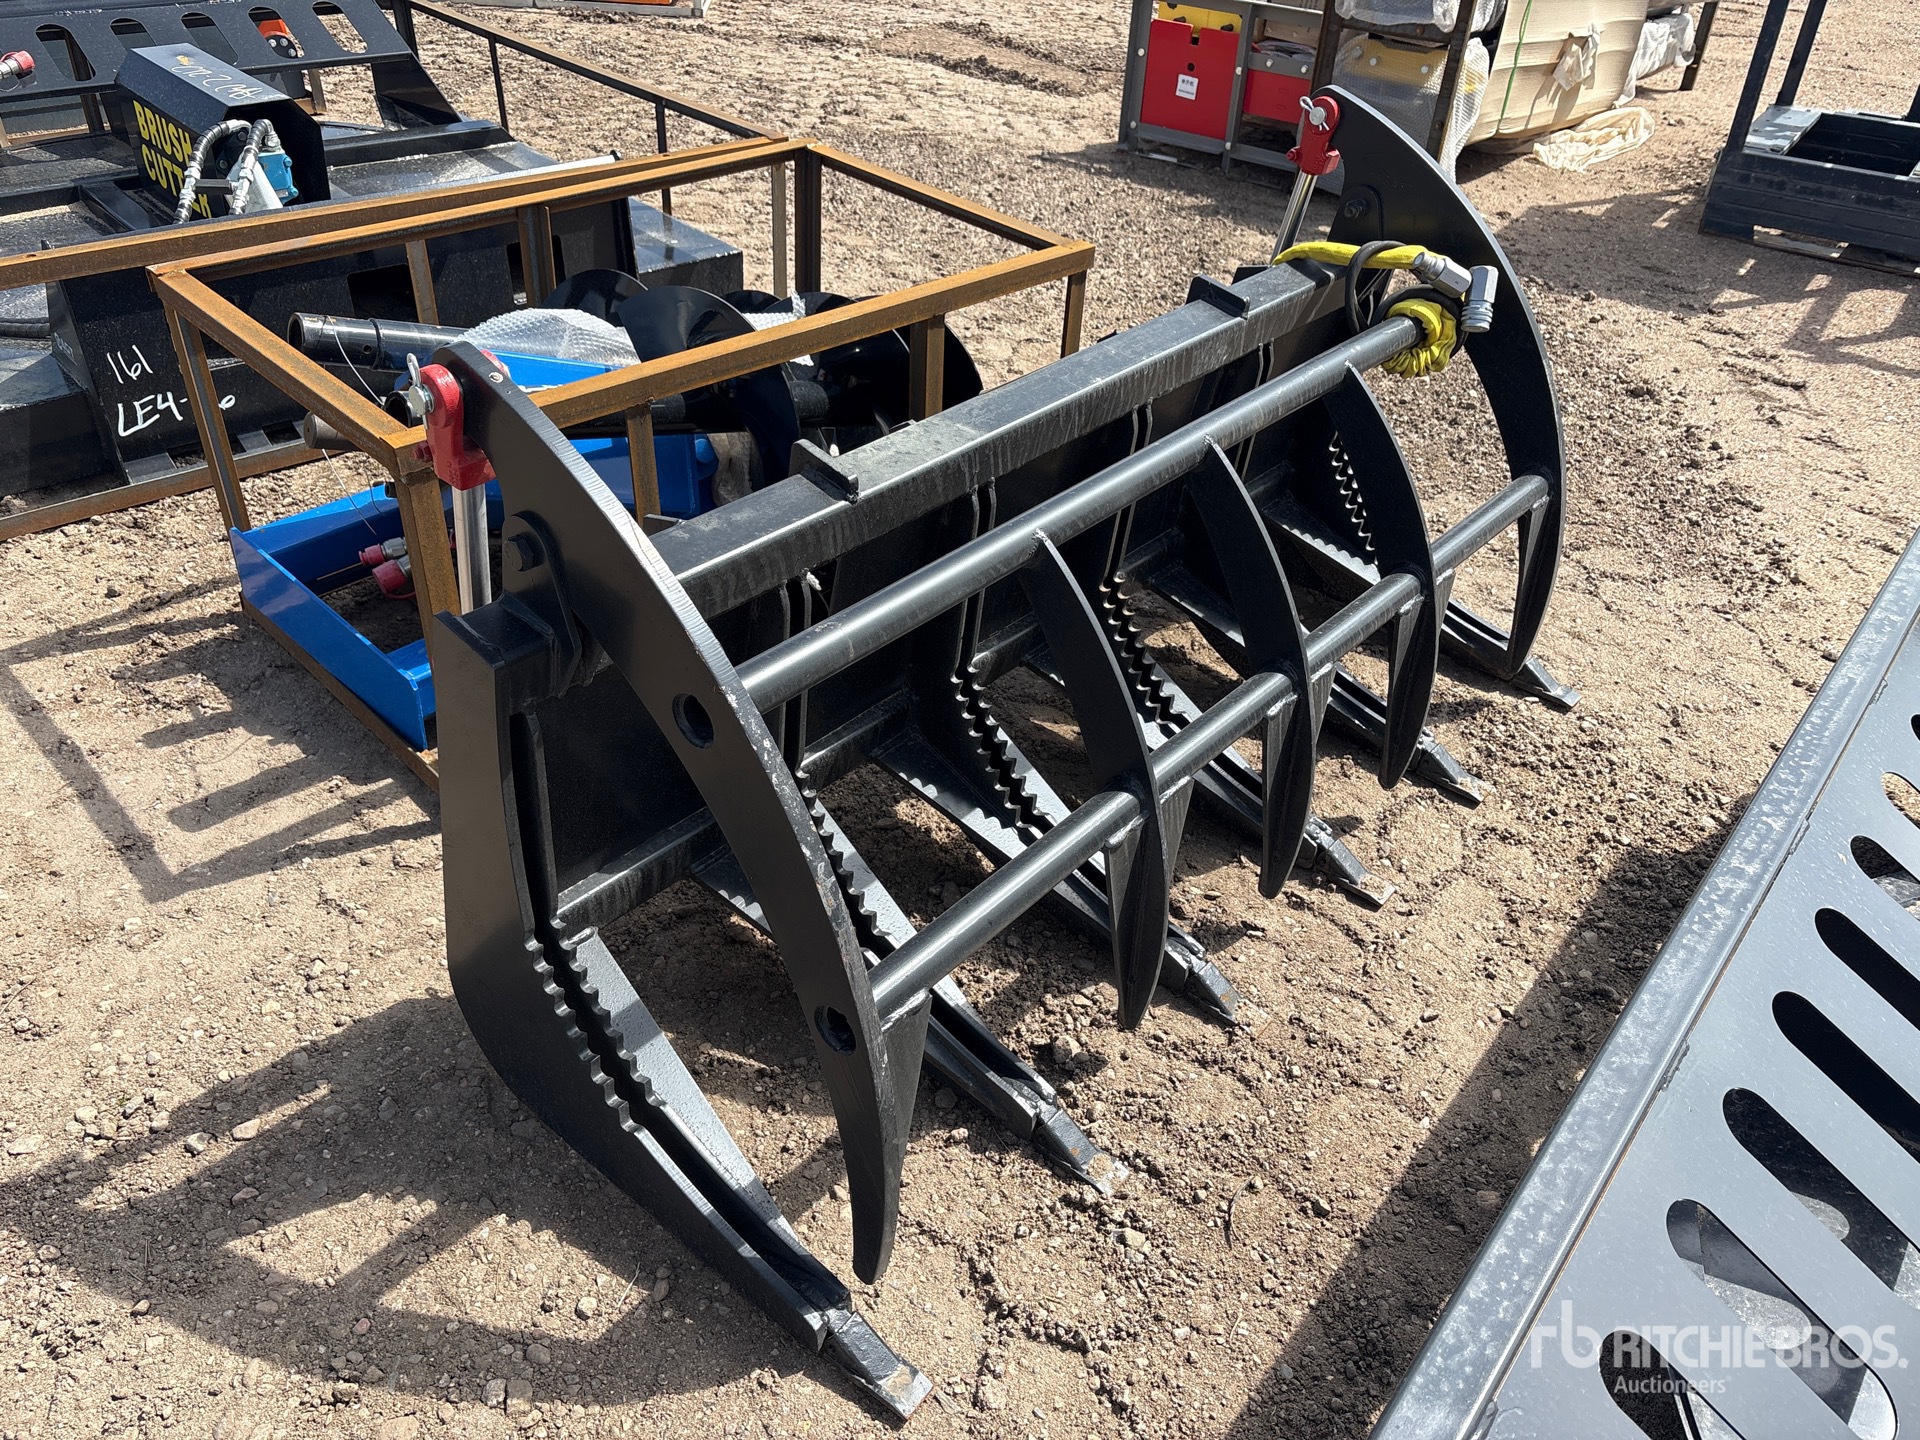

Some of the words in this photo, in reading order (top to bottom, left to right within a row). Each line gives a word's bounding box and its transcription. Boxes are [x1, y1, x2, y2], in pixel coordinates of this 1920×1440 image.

[132, 100, 193, 167] BRUSH
[141, 143, 213, 219] CUTTR
[106, 345, 154, 384] 161
